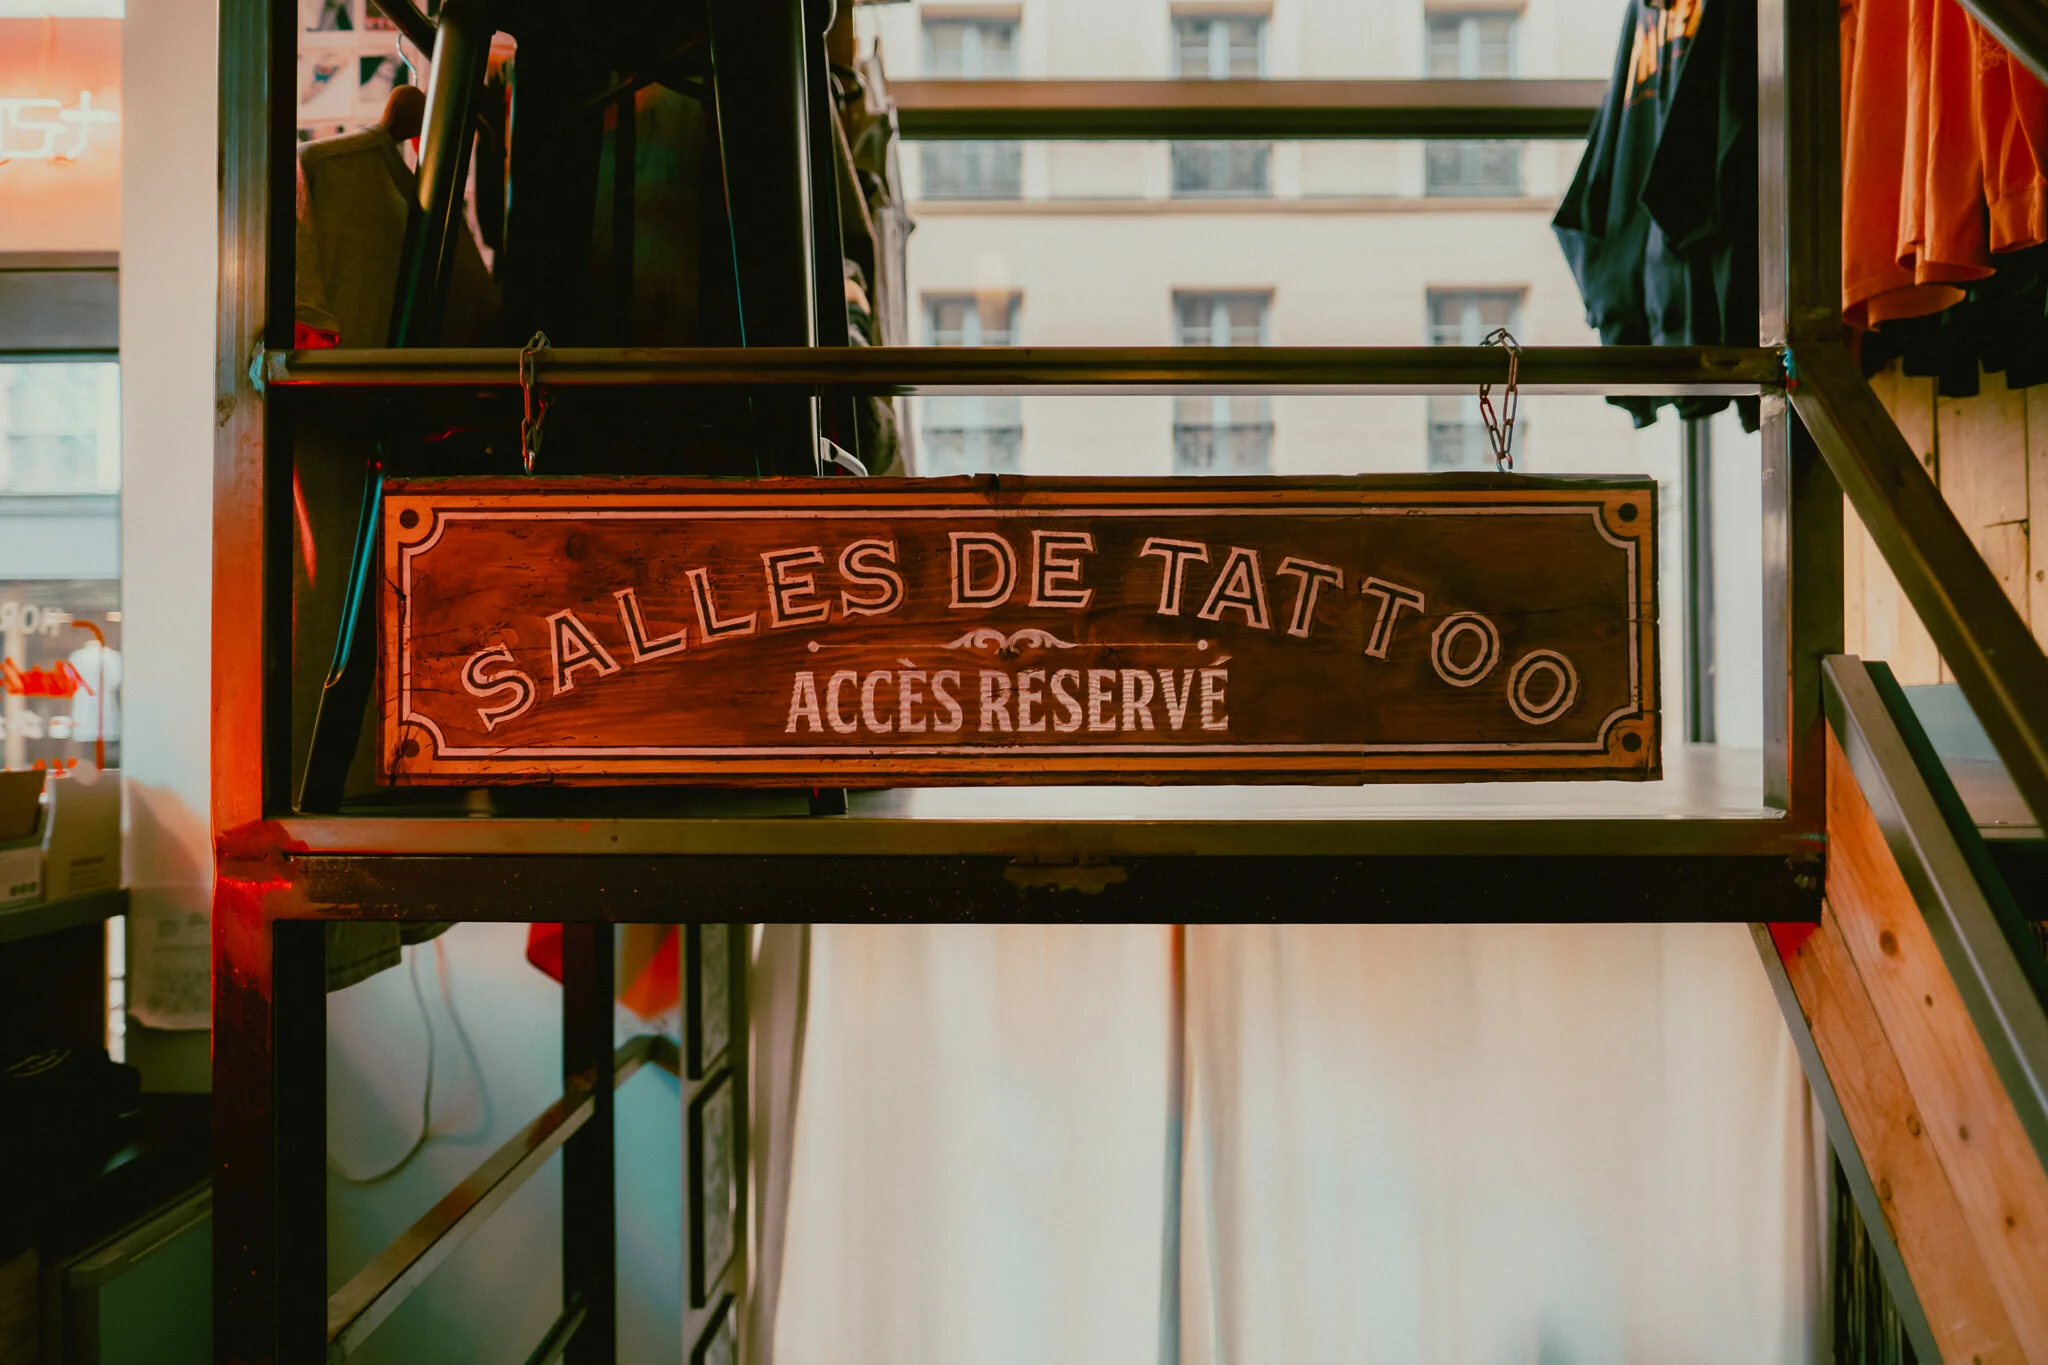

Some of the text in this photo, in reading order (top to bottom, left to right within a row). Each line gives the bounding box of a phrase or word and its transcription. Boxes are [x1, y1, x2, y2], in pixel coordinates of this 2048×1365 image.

[461, 530, 1580, 732] SALLES DE TATTOO
[784, 657, 964, 734] ACCÈS
